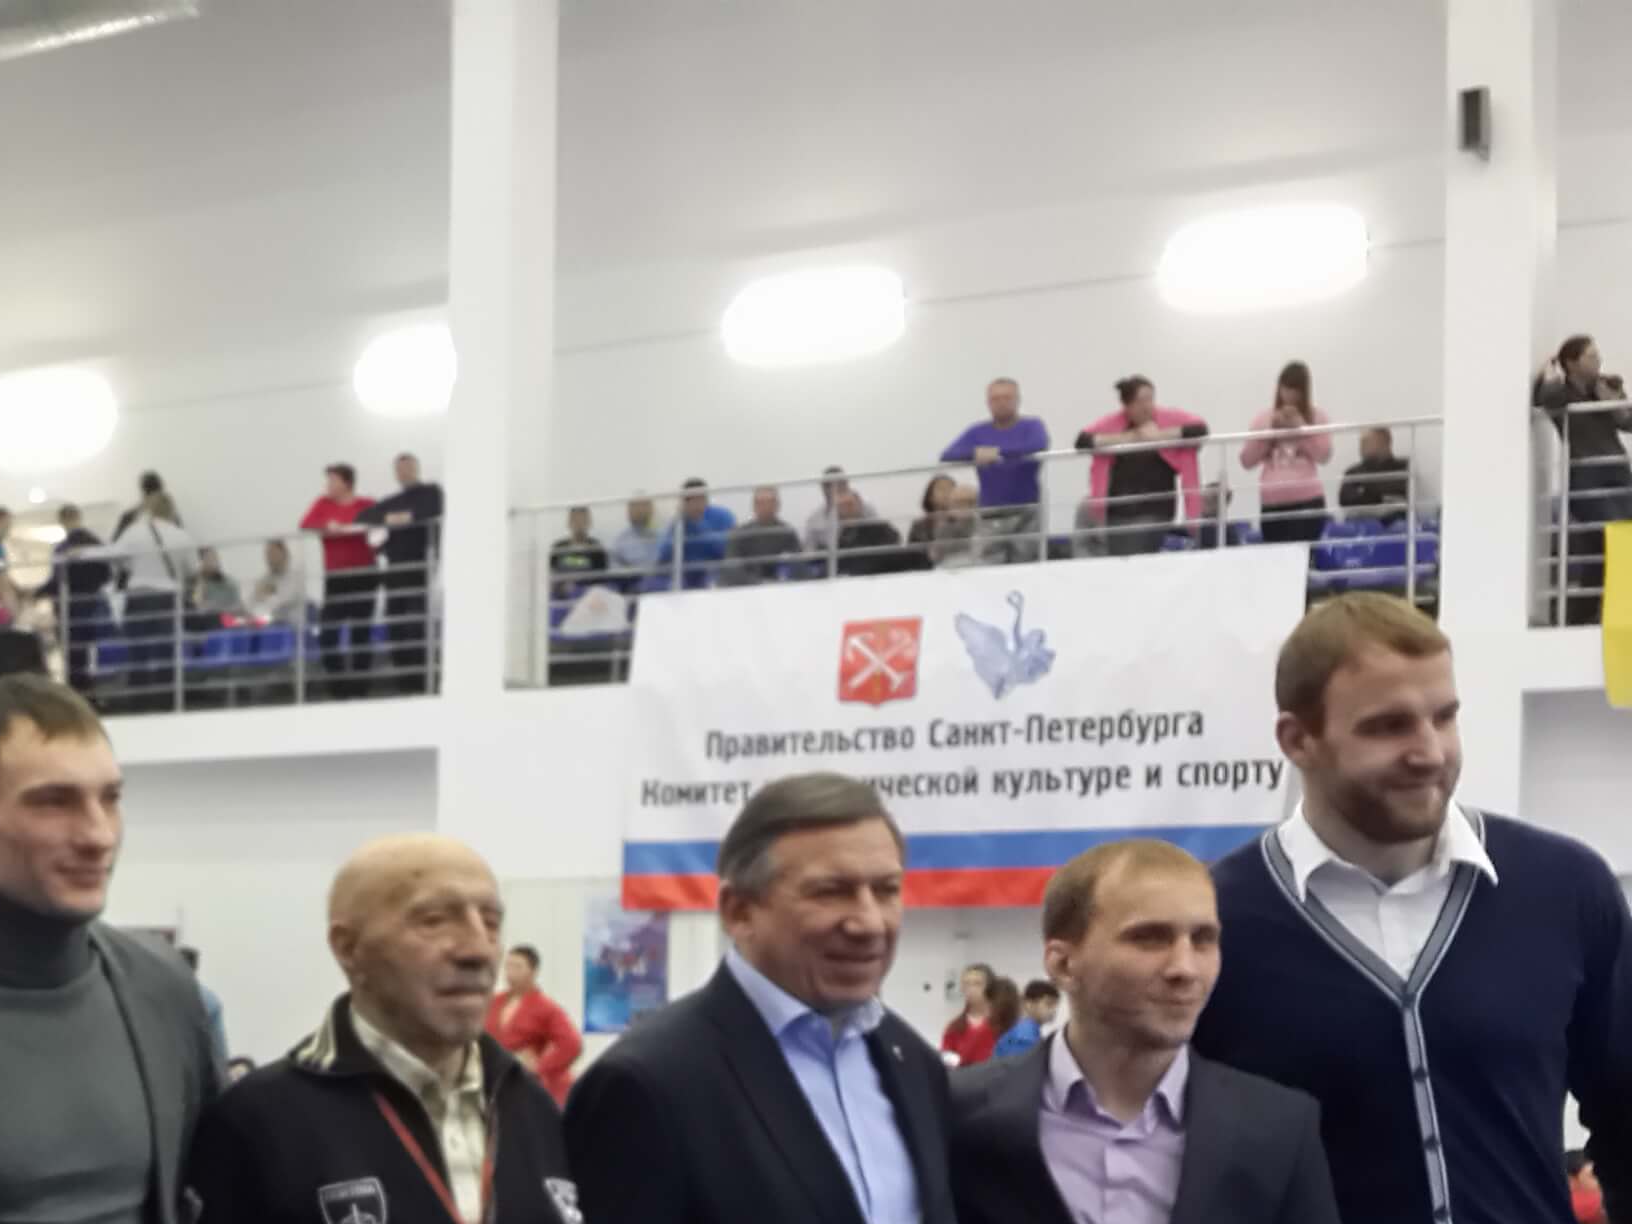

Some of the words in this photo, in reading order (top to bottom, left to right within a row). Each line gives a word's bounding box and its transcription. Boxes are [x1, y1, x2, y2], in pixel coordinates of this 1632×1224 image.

[704, 724, 916, 763] Правительство
[928, 708, 1205, 749] Санкт-Петербурга
[640, 778, 753, 807] Комитет
[868, 765, 979, 797] ческой
[993, 764, 1132, 800] культуре
[1143, 764, 1163, 789] и
[1176, 758, 1284, 792] спорту
